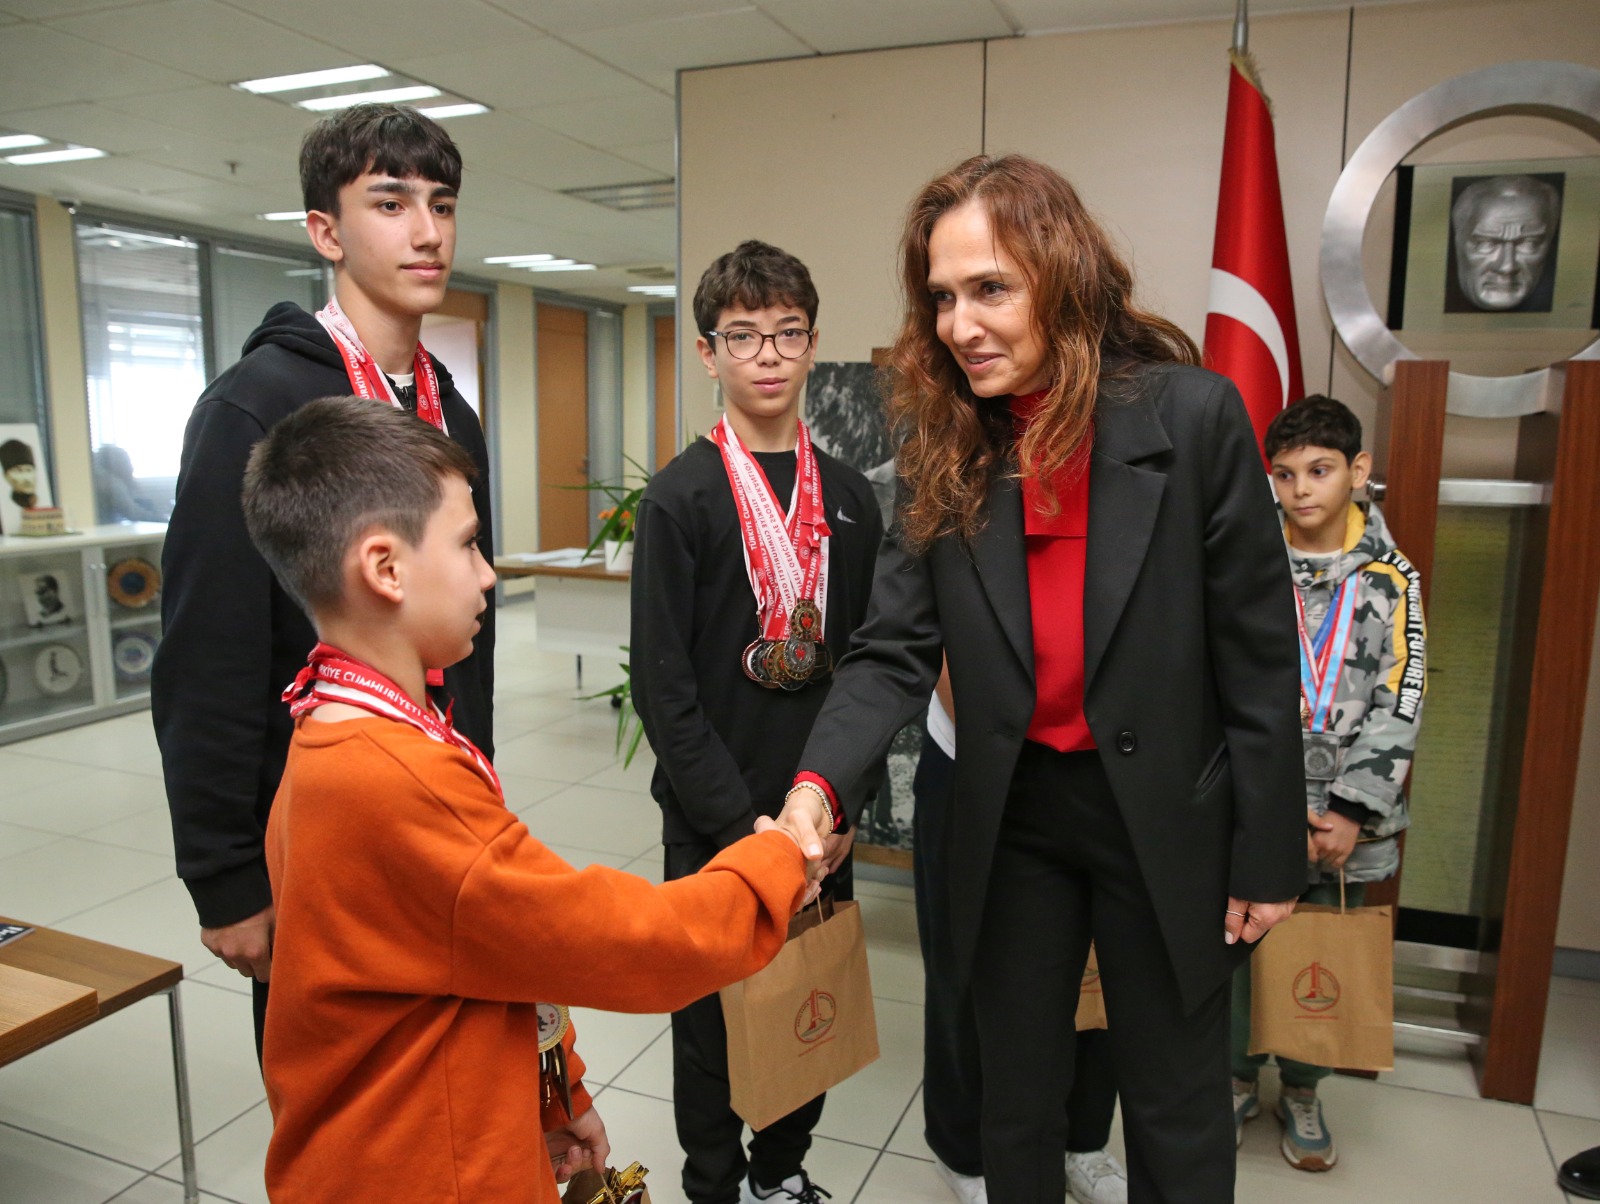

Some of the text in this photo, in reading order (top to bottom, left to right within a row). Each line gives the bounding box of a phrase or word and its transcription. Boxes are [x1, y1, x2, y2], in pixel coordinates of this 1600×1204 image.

[745, 520, 757, 550] TÜRKİYE
[1392, 555, 1411, 571] TO
[1403, 632, 1424, 689] FUTURE
[343, 672, 421, 716] CUMHURİYETİ
[1398, 688, 1421, 718] RUN
